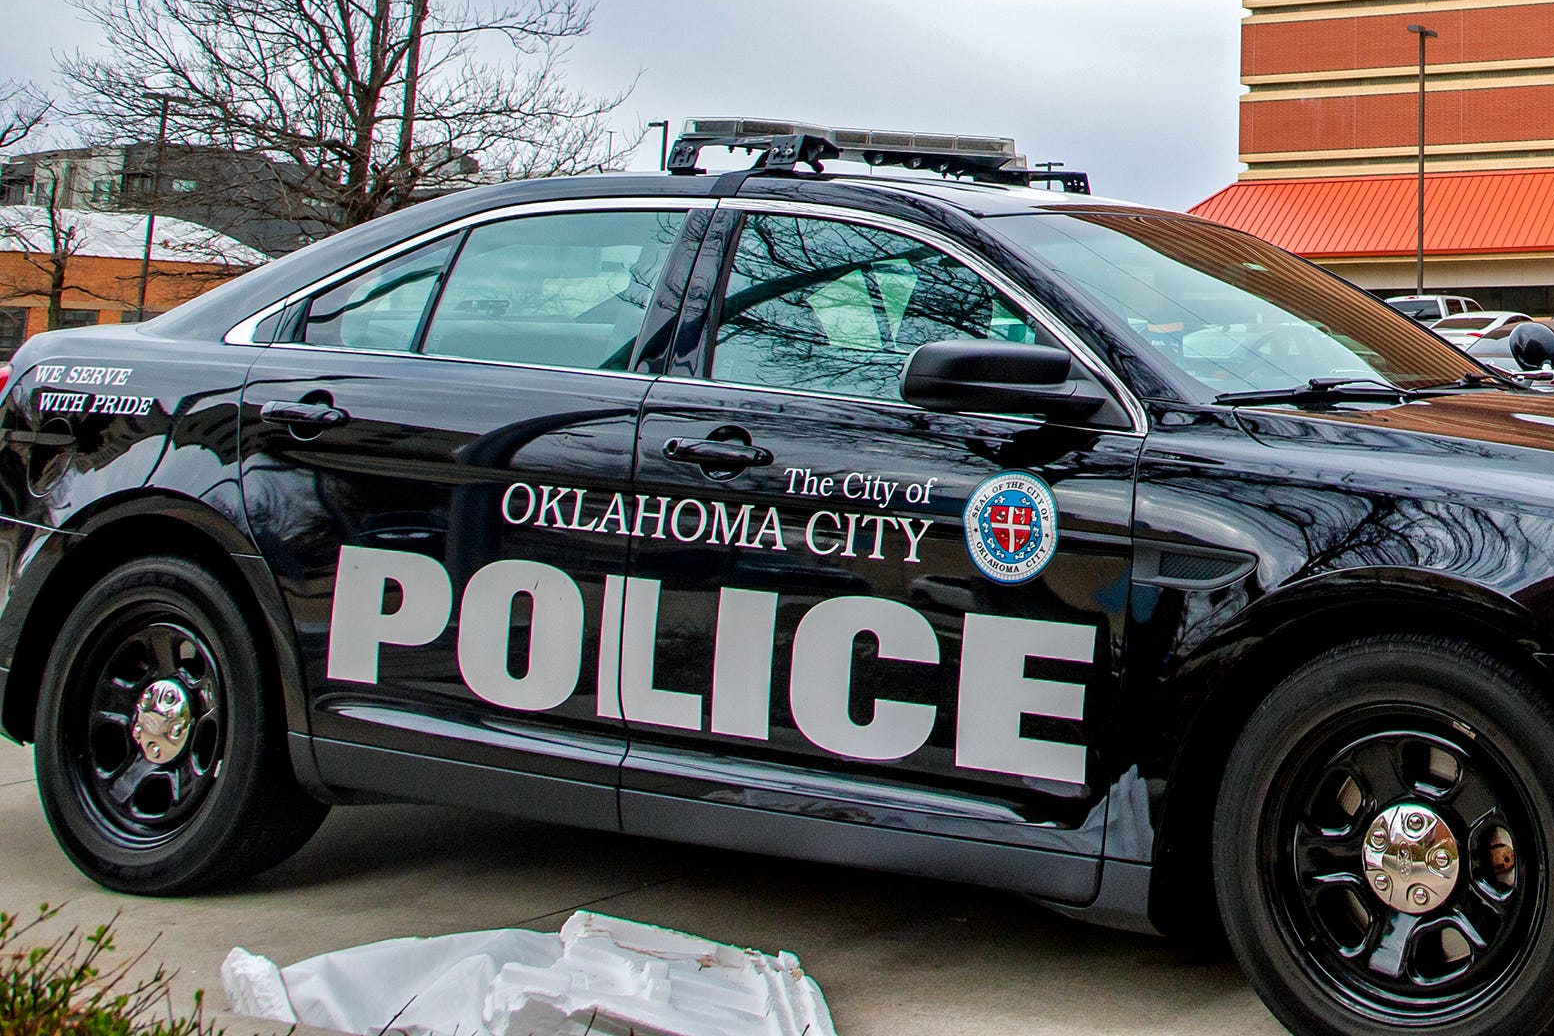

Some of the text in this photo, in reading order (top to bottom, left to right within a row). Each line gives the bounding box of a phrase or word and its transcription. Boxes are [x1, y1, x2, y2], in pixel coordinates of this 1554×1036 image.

[35, 365, 133, 386] WE SERVE
[39, 392, 154, 416] WITH PRIDE
[784, 467, 939, 509] The City of
[972, 481, 1050, 523] SEAL OF THE CITY OF
[501, 482, 935, 564] OKLAHOMA CITY
[976, 541, 1046, 573] OKLAHOMA CITY
[326, 544, 1098, 785] POLICE
